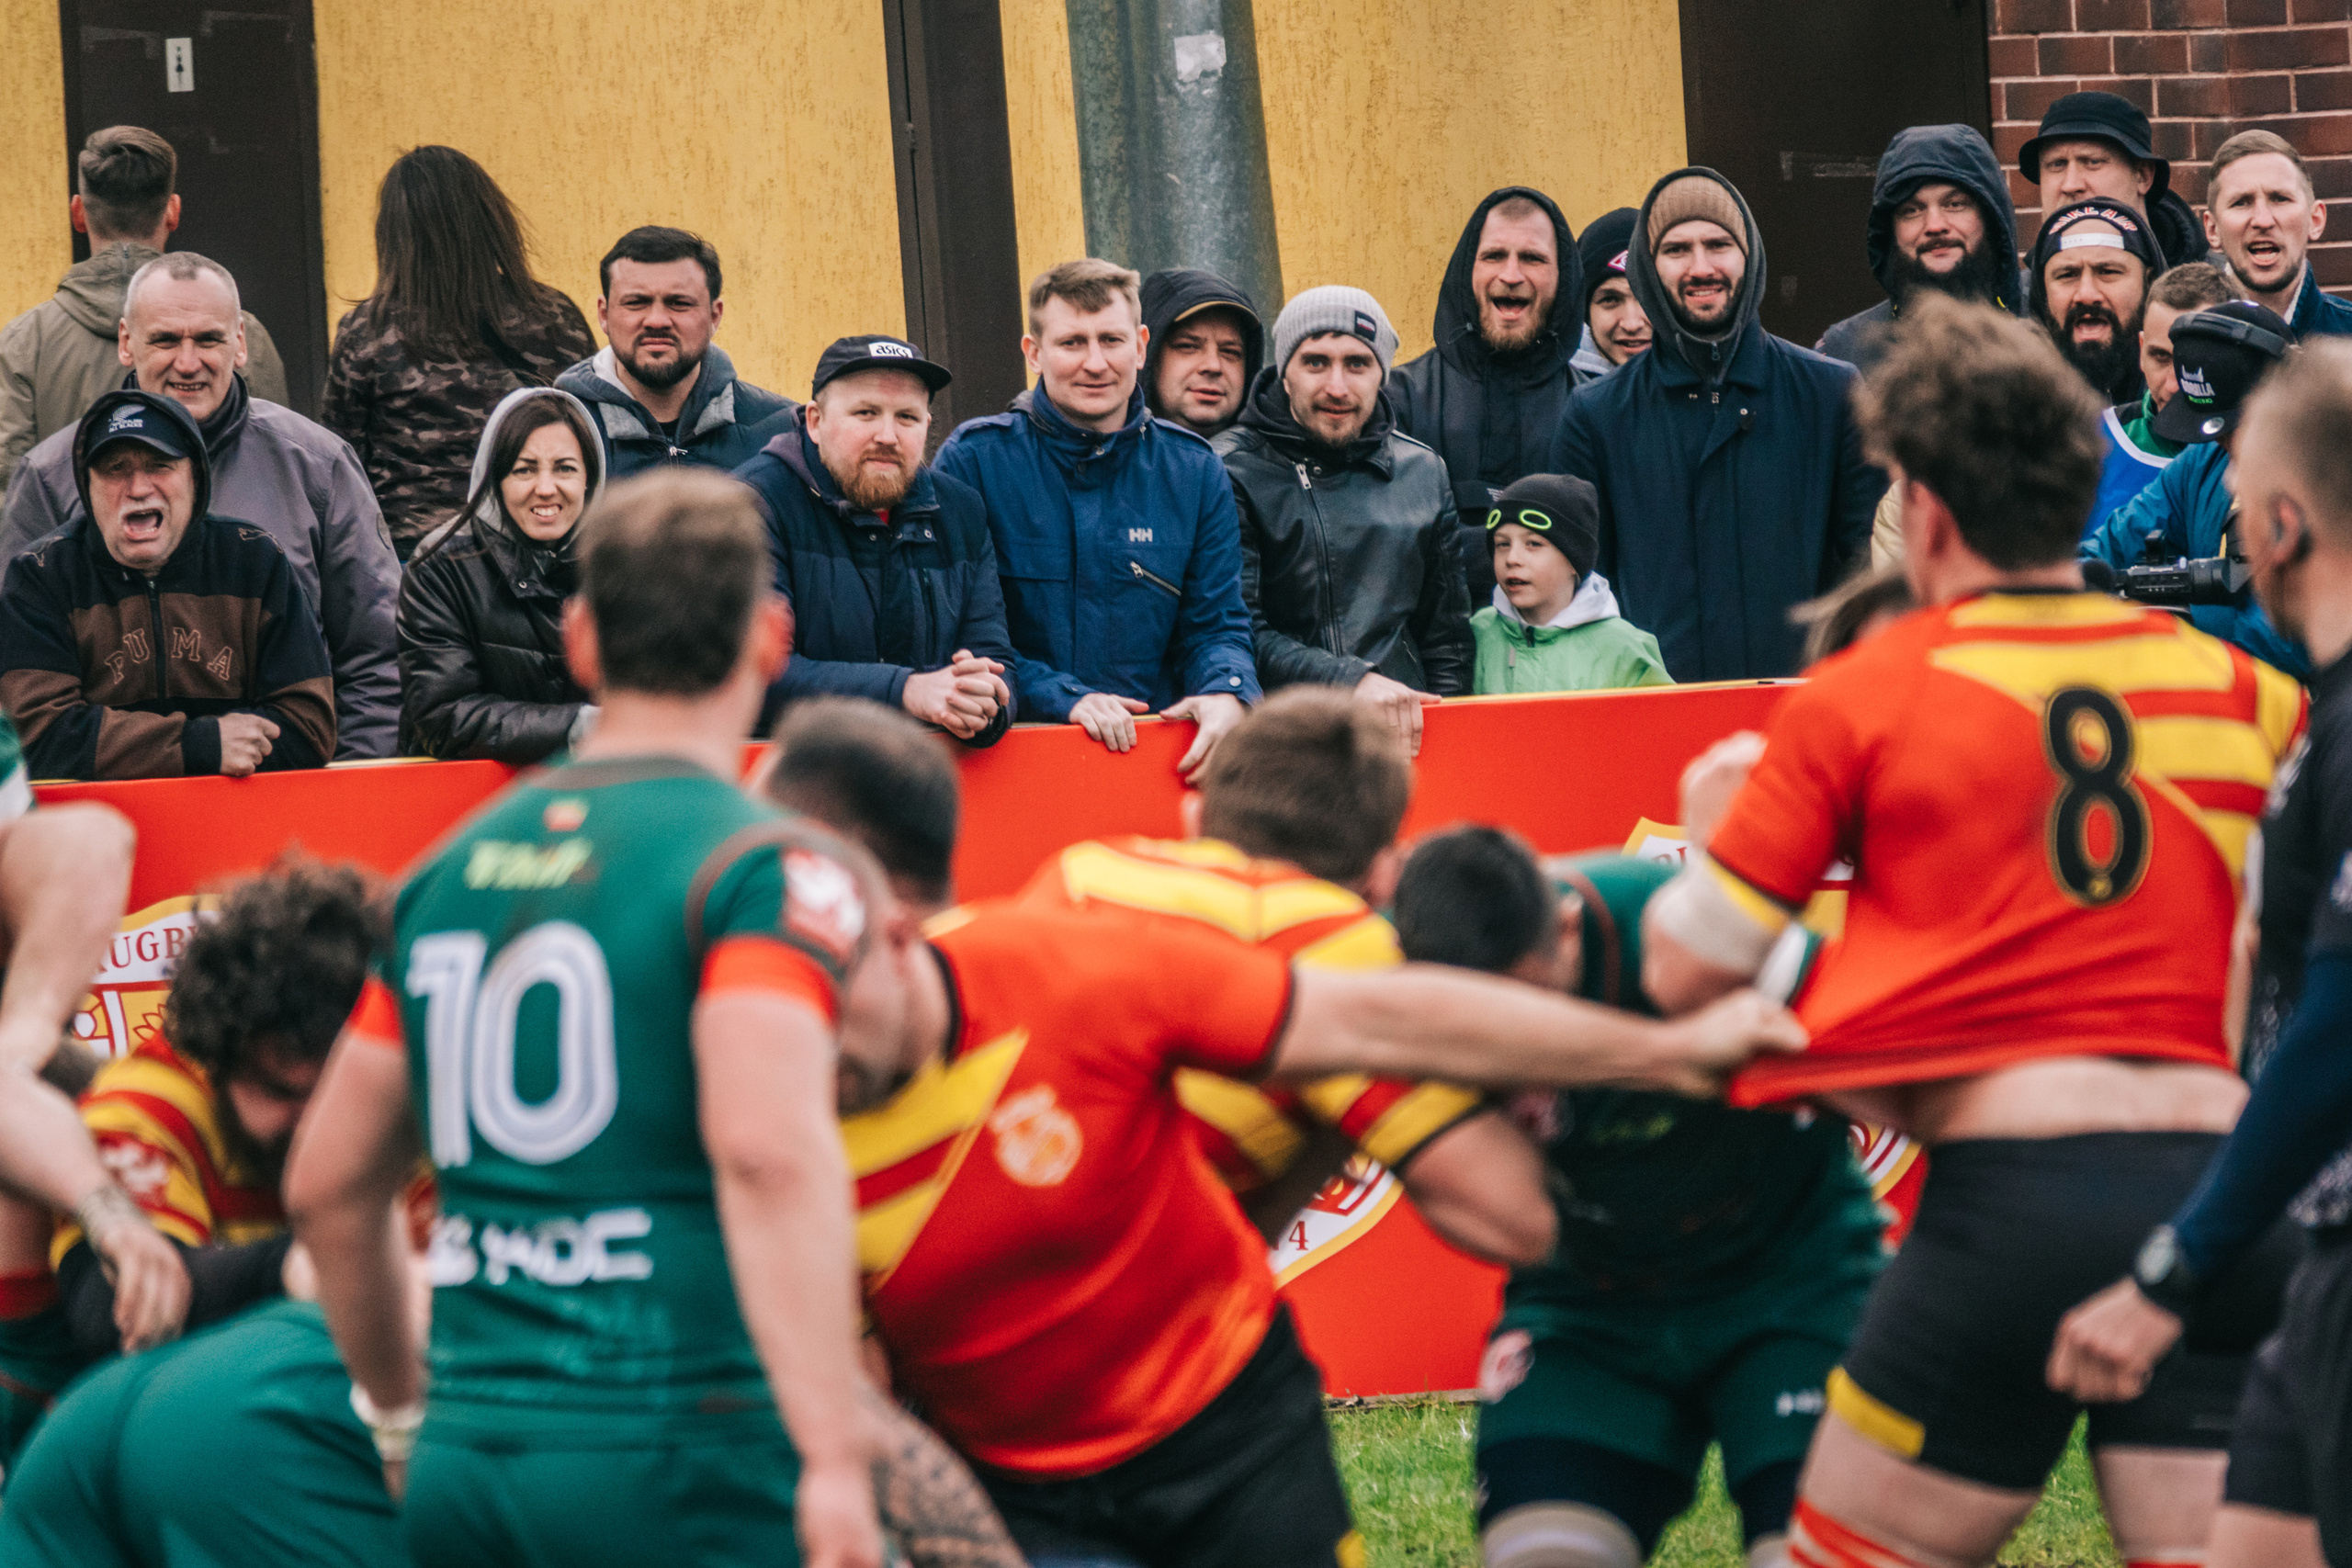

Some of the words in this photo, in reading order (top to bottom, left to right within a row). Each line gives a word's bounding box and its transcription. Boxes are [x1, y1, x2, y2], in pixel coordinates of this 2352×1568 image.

[876, 344, 910, 358] asics
[1129, 527, 1153, 542] HH
[105, 627, 232, 684] PUMA
[2044, 685, 2152, 906] 8
[98, 925, 198, 973] UGB
[406, 921, 618, 1168] 10
